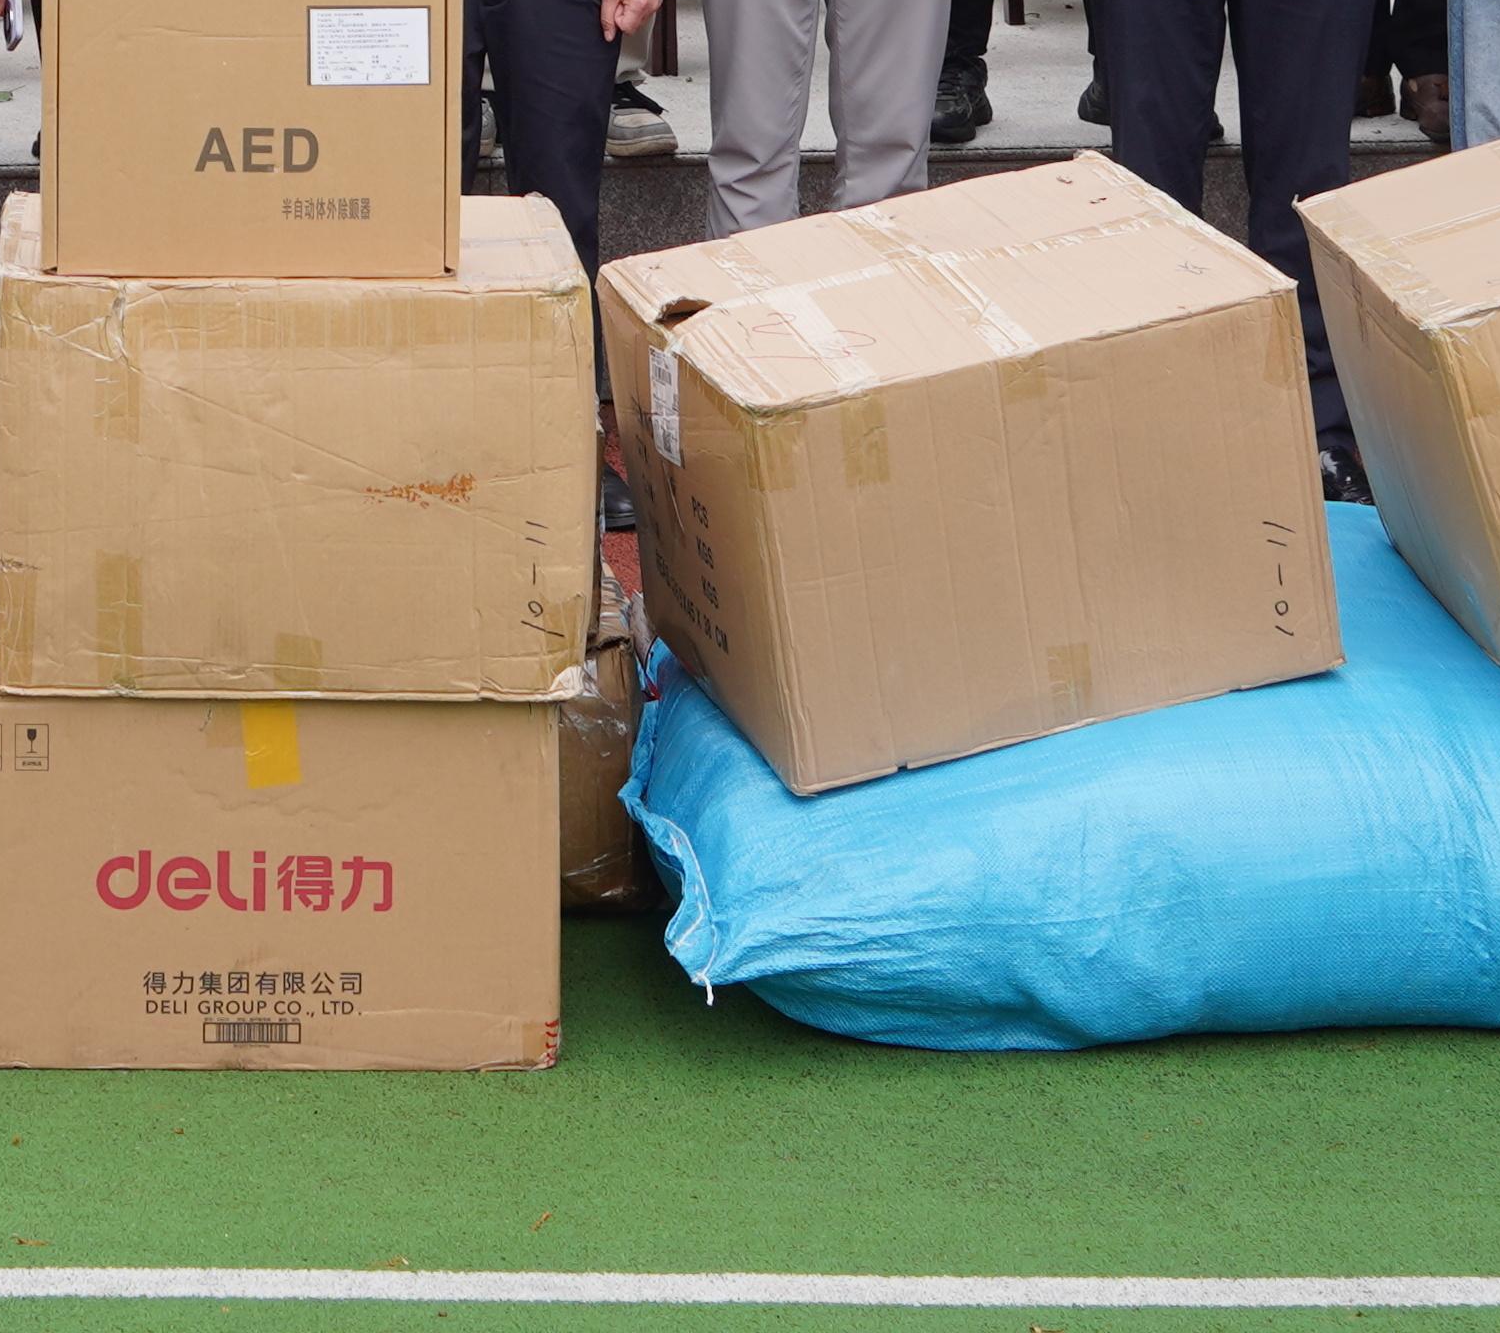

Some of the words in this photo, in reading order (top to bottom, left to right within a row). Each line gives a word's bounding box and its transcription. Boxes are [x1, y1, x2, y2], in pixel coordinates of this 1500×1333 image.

[194, 127, 320, 174] AED
[281, 198, 371, 222] 半自动体外除颤器
[143, 970, 364, 997] 得力集团有限公司
[145, 1000, 189, 1016] DELI
[197, 999, 268, 1016] GROUP
[321, 1000, 363, 1017] LTD.
